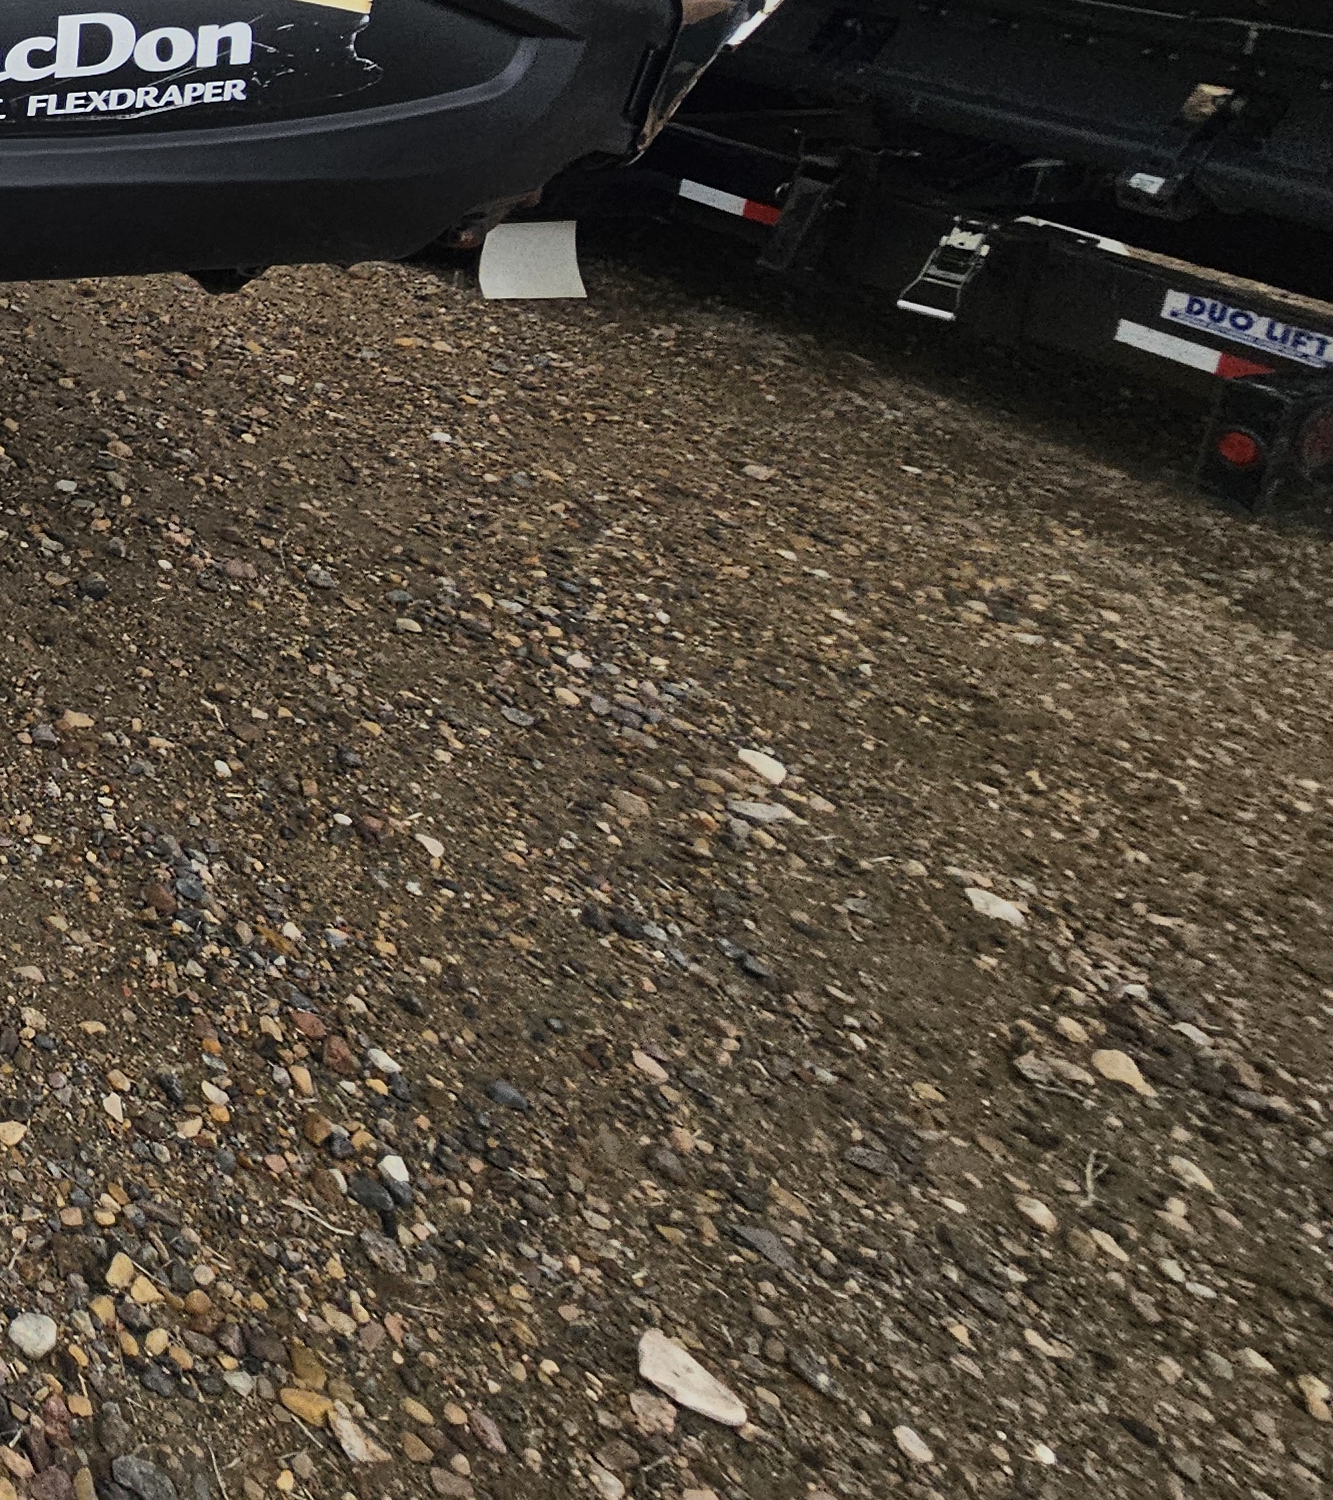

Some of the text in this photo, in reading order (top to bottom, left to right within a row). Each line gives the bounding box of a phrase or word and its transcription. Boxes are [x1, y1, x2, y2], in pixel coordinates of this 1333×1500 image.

[27, 79, 247, 117] FLEXDRAPER
[1186, 295, 1254, 331] DUO
[1265, 319, 1330, 357] LIFT
